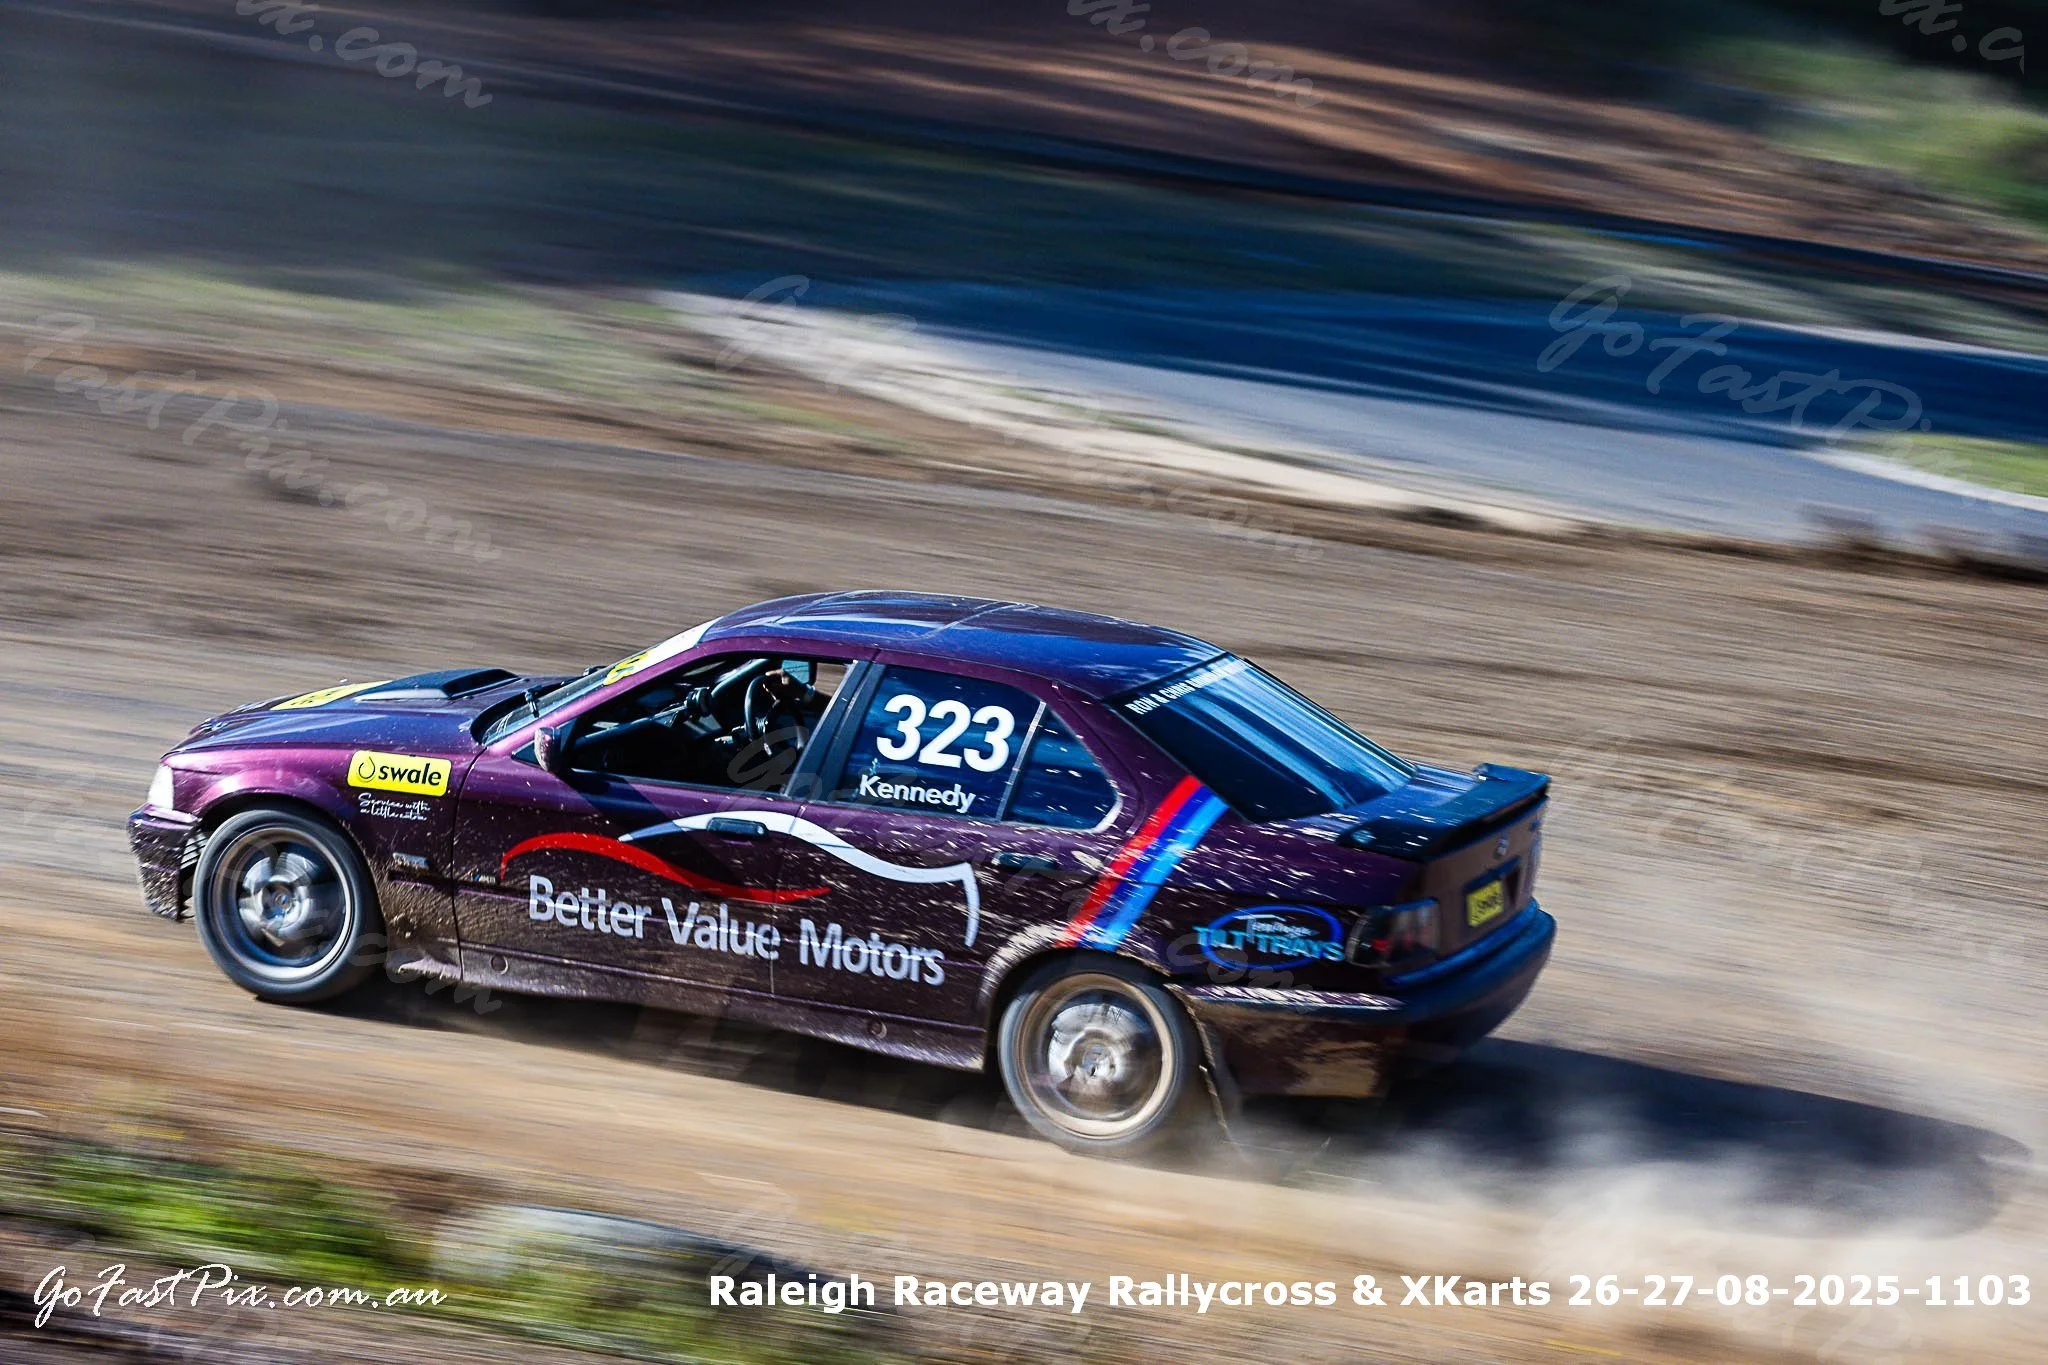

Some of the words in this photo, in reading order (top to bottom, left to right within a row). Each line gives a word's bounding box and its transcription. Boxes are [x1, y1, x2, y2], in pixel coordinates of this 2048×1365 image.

[876, 694, 1016, 772] 323
[378, 763, 442, 786] swale
[859, 774, 977, 813] Kennedy
[528, 875, 651, 941] Better
[661, 898, 781, 960] Value
[799, 918, 945, 986] Motors
[1254, 933, 1346, 962] TRAYS
